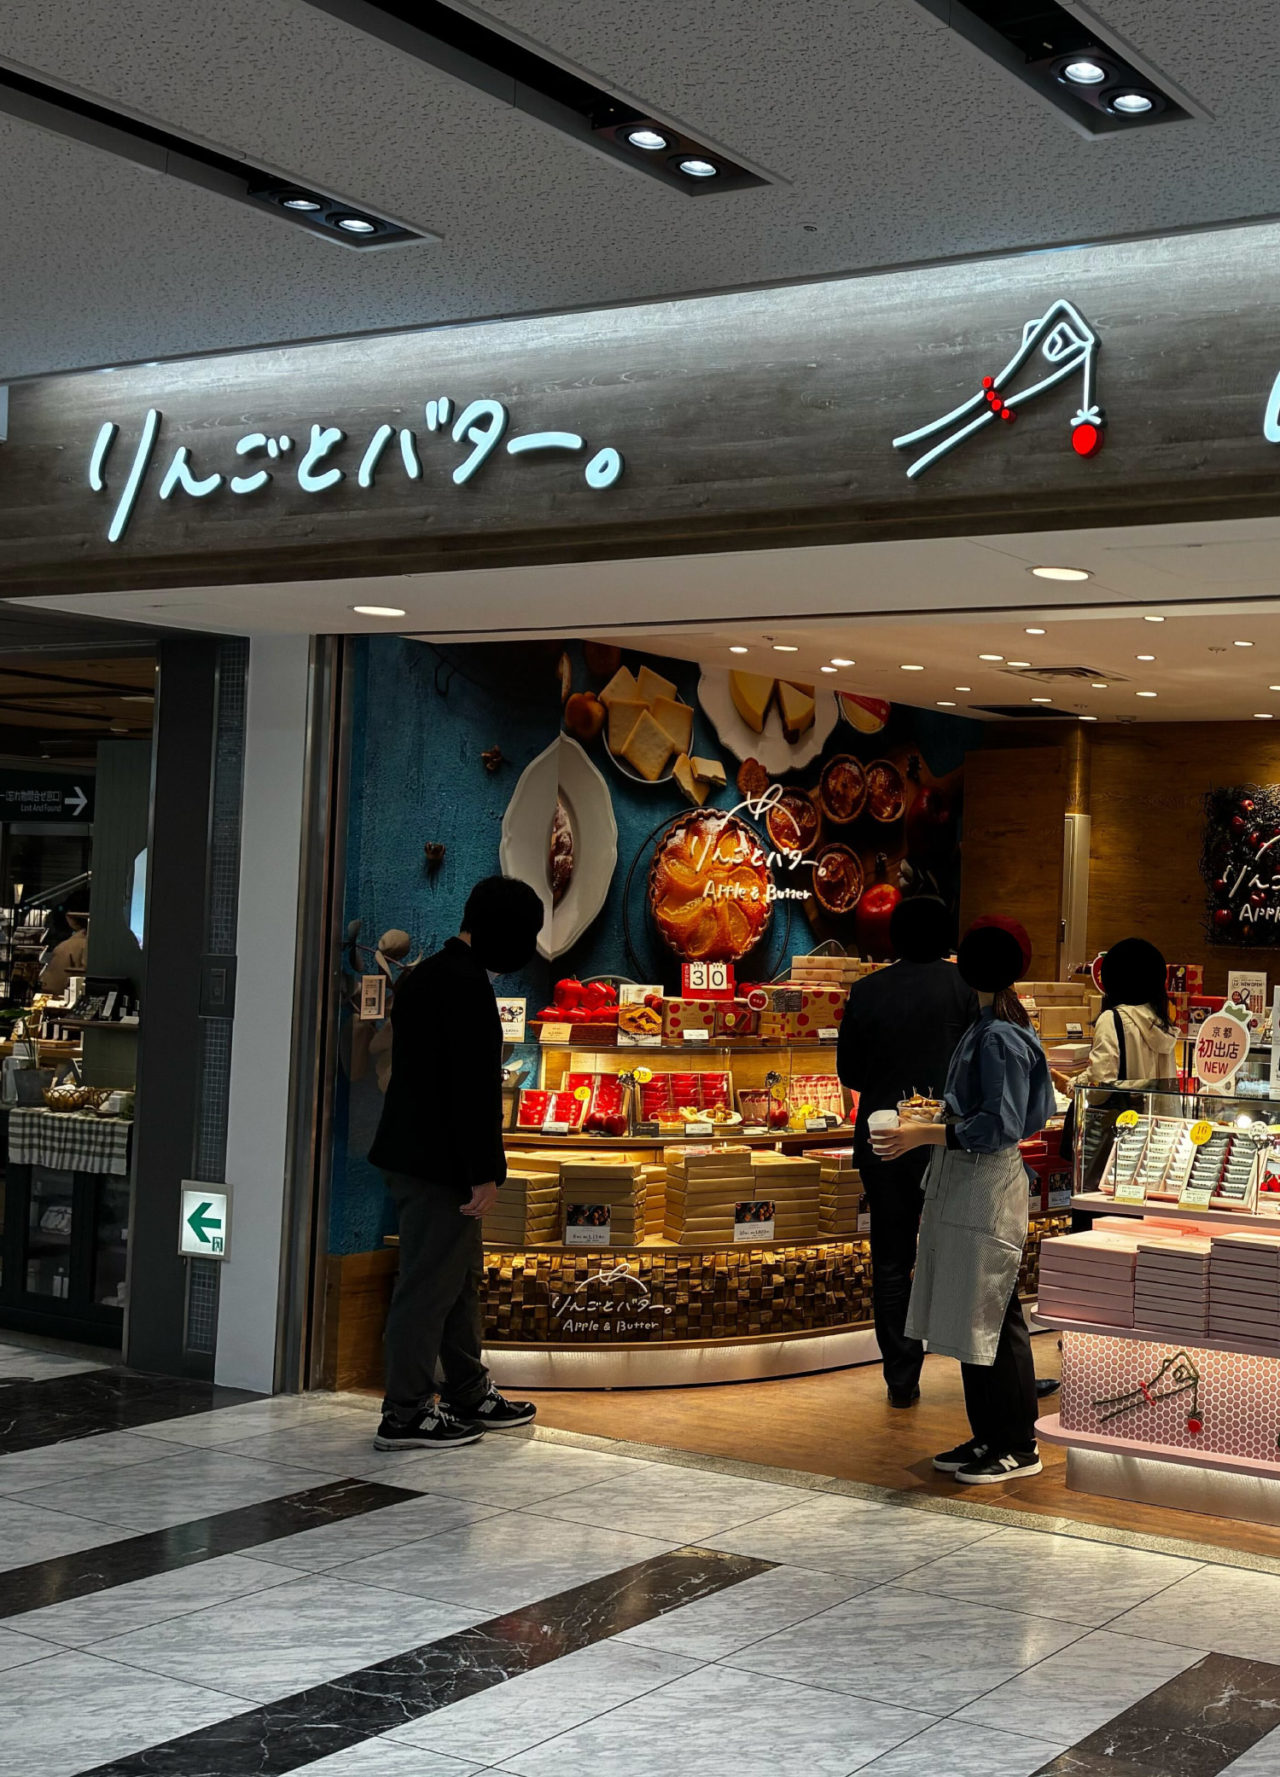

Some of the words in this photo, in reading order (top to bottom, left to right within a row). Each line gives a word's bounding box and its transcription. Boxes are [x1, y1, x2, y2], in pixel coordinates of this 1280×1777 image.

[89, 397, 624, 543] りんごとバター。
[690, 834, 827, 877] りんごとバター。
[703, 880, 747, 901] Apple
[750, 886, 760, 900] &
[766, 883, 812, 903] Butter
[692, 970, 724, 986] 30
[1212, 1026, 1233, 1039] 京都
[1198, 1037, 1240, 1059] 初出店
[1203, 1060, 1229, 1075] NEW
[551, 1295, 673, 1317] りんごとバター。
[562, 1319, 599, 1333] Apple
[603, 1321, 611, 1332] &
[616, 1320, 660, 1334] Butter
